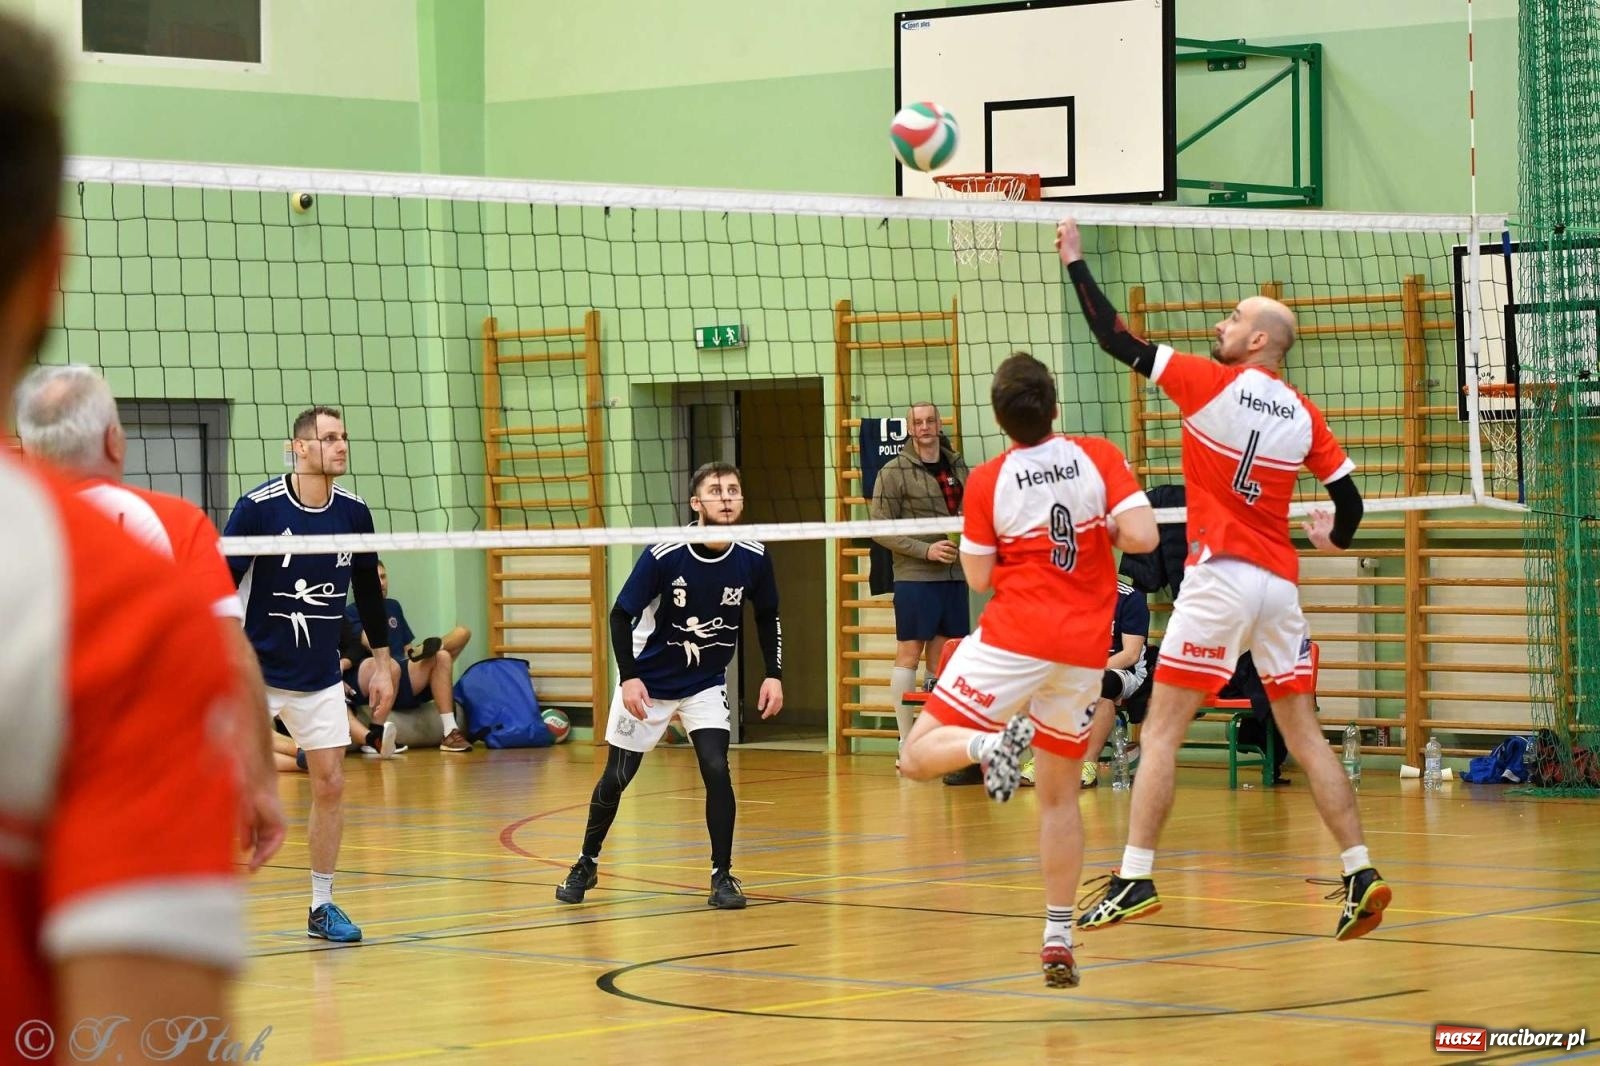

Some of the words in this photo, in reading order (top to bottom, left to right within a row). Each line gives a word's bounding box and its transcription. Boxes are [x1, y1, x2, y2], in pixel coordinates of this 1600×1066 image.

[1239, 388, 1295, 420] Henkel
[878, 443, 905, 456] POLIC
[1015, 459, 1081, 490] Henkel
[1232, 429, 1261, 505] 4
[1050, 502, 1076, 573] 9
[672, 588, 687, 608] 3
[1181, 641, 1227, 660] Persil
[951, 675, 997, 709] Persil
